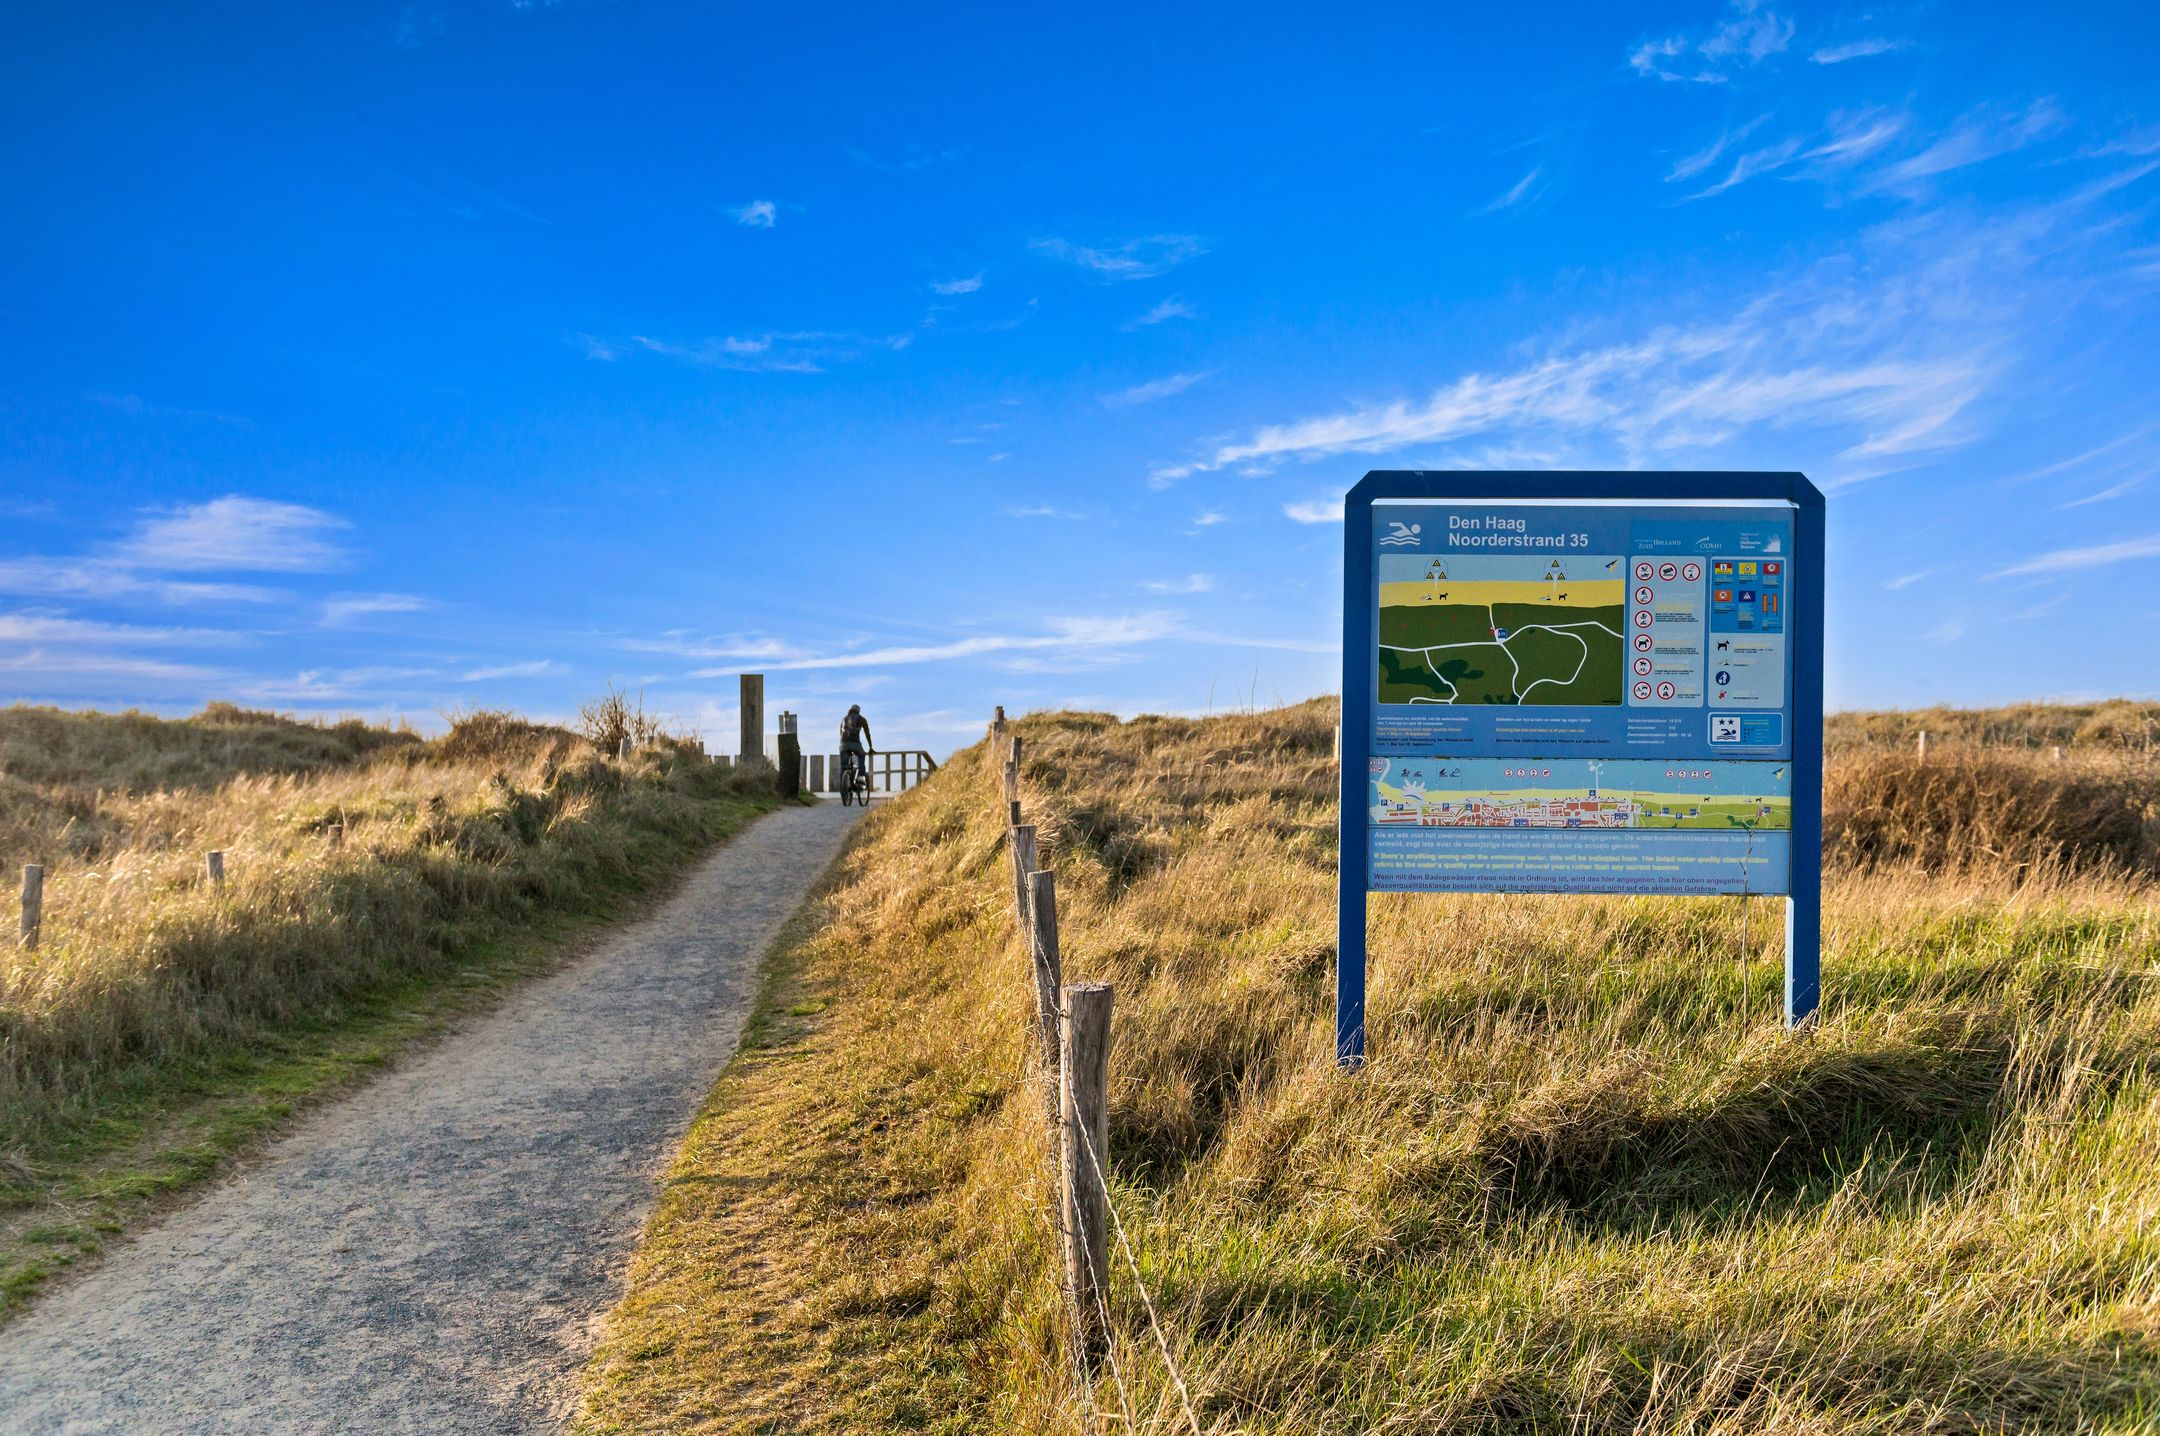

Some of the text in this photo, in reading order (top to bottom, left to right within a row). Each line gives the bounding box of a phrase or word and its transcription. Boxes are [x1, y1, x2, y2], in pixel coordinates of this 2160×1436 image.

[1449, 516, 1526, 532] Den Haag
[1449, 533, 1589, 547] Noorderstrand 35
